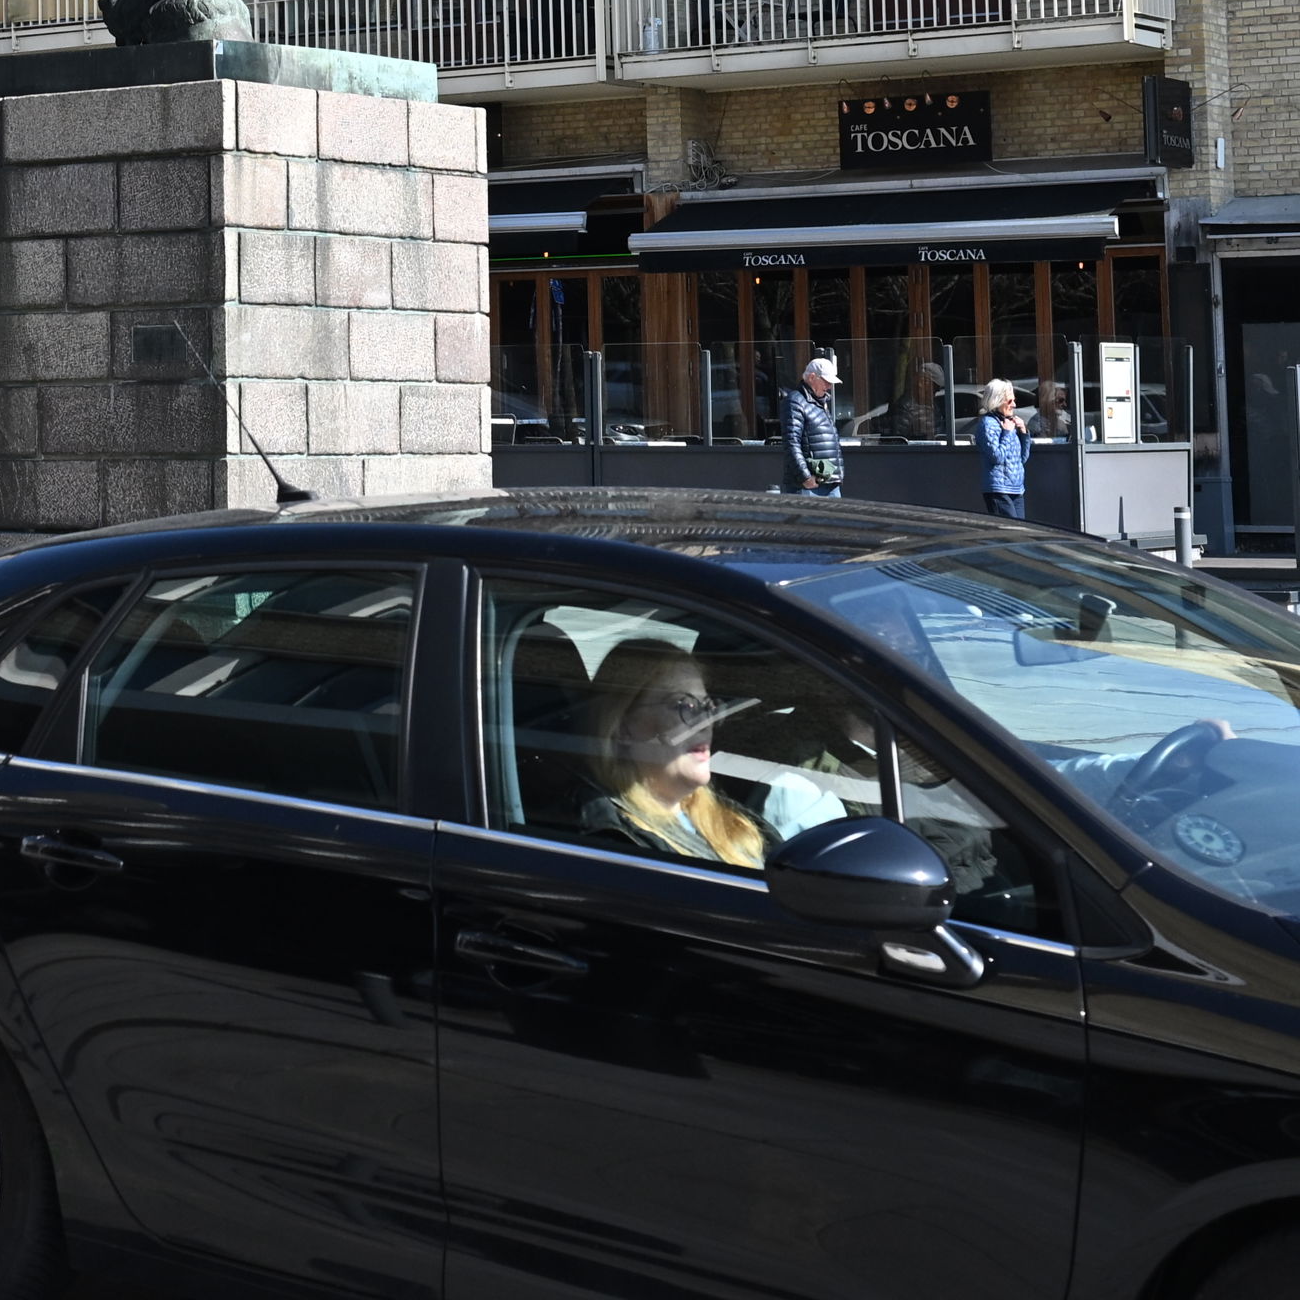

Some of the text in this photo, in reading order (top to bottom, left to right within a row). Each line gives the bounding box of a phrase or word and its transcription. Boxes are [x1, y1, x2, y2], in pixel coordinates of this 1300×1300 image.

[850, 124, 868, 132] CAFE
[850, 125, 978, 153] TOSCANA
[1162, 134, 1191, 150] TOSCANA
[743, 254, 806, 267] TOSCANA
[918, 248, 987, 262] TOSCANA
